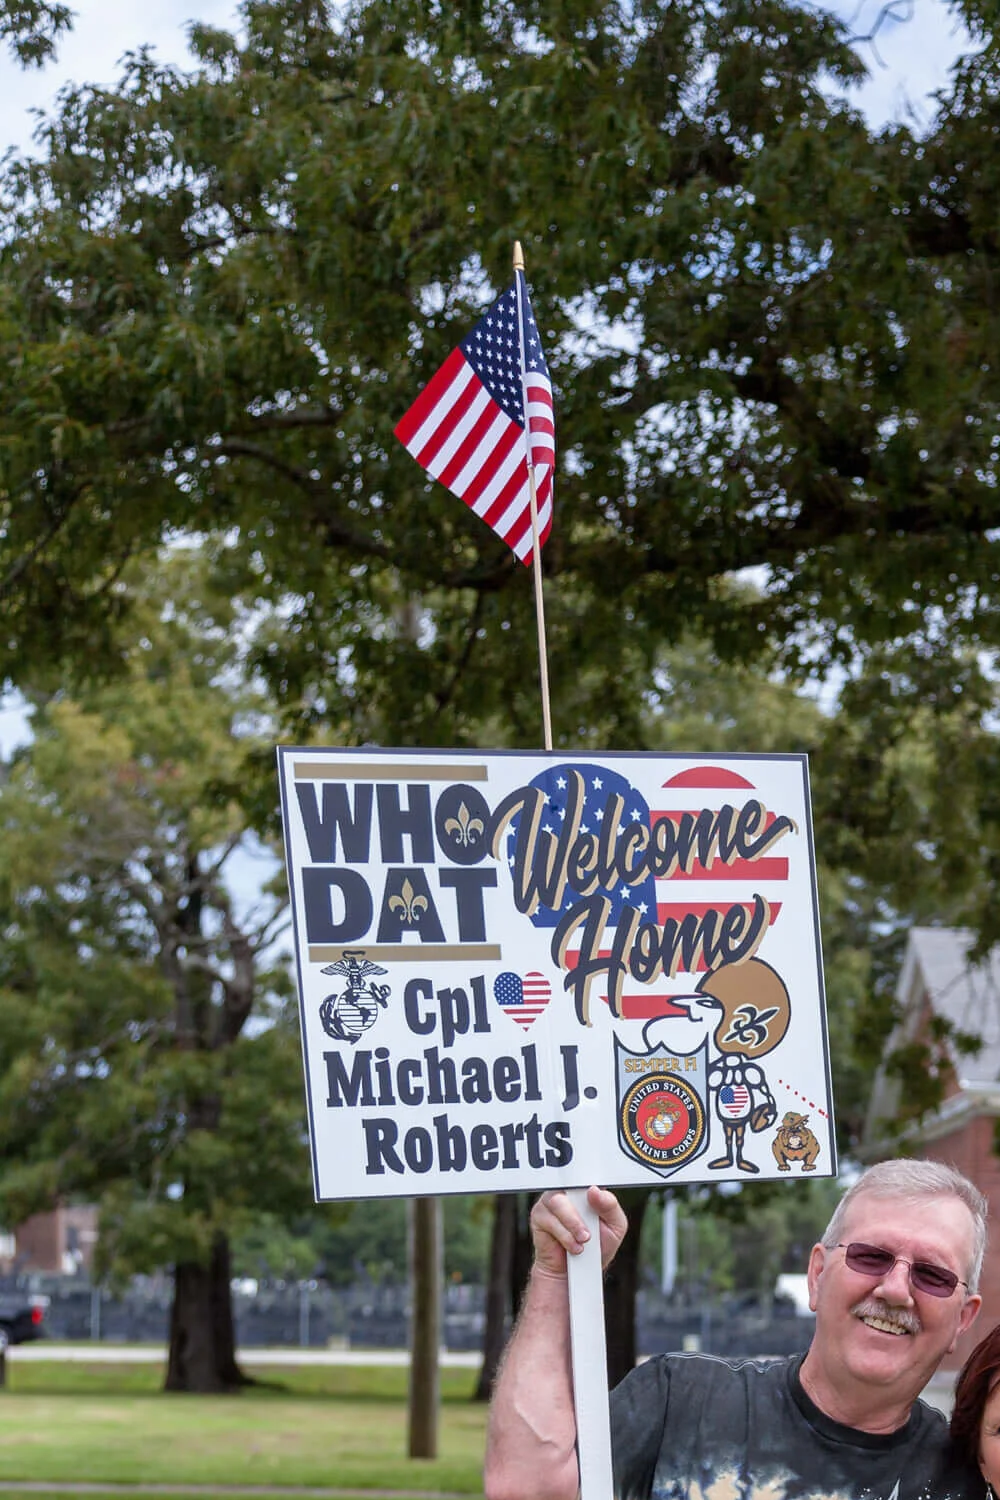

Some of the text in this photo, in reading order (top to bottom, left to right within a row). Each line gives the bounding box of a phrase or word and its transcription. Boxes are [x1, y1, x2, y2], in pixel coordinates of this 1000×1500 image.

[294, 781, 493, 866] WHO
[490, 768, 799, 915] Welcome
[301, 867, 499, 945] DAT
[550, 893, 772, 1028] Home
[403, 975, 493, 1048] Cpl
[322, 1043, 599, 1112] Michael J.
[623, 1056, 698, 1074] SEMPER FI
[629, 1082, 695, 1113] UNITED STATES
[361, 1114, 573, 1176] Roberts
[631, 1128, 696, 1159] MARINE CORPS
